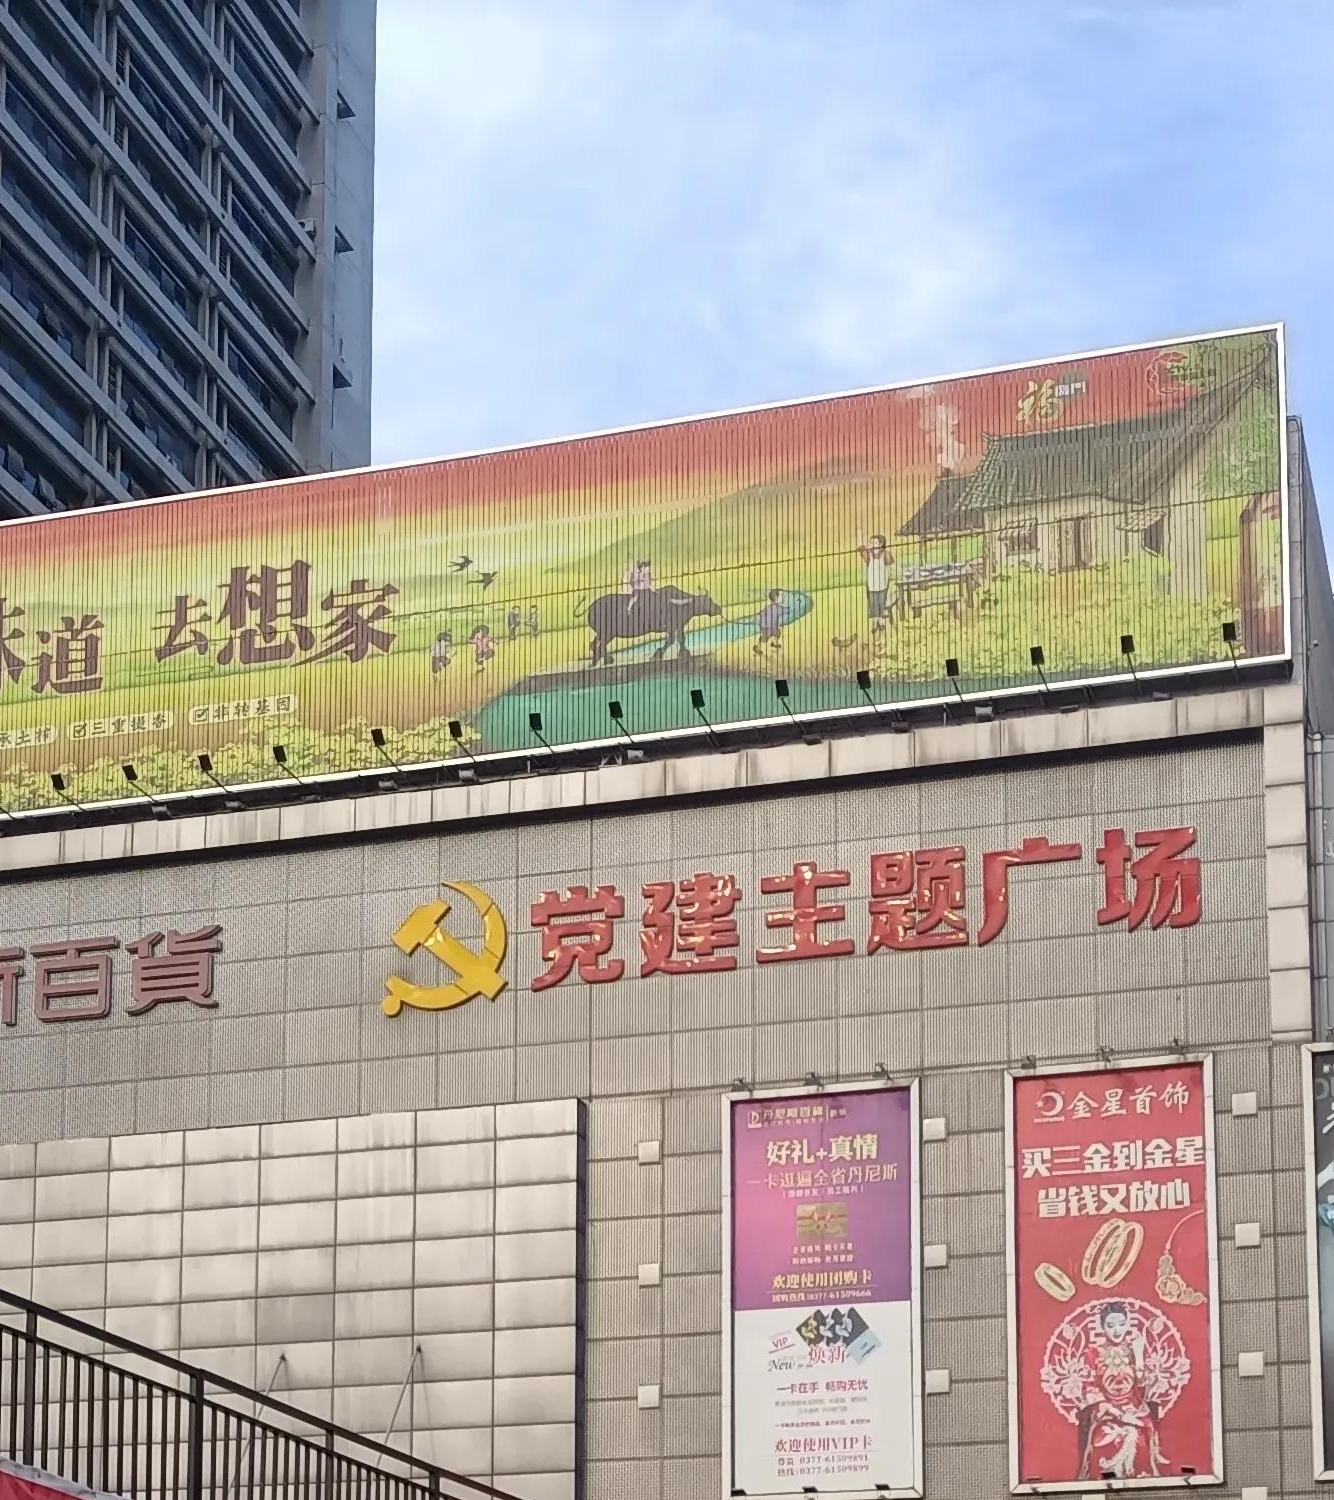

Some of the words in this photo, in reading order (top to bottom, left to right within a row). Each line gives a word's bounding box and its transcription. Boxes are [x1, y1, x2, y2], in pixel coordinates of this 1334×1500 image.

[154, 560, 400, 667] 去想家
[214, 696, 292, 721] 非转基因
[530, 826, 1203, 993] 党建主题广场
[1067, 1080, 1190, 1120] 金星首饰
[767, 1133, 879, 1167] 好礼+真情
[1021, 1135, 1205, 1180] 买三金到金星
[1037, 1178, 1191, 1219] 省钱又放心
